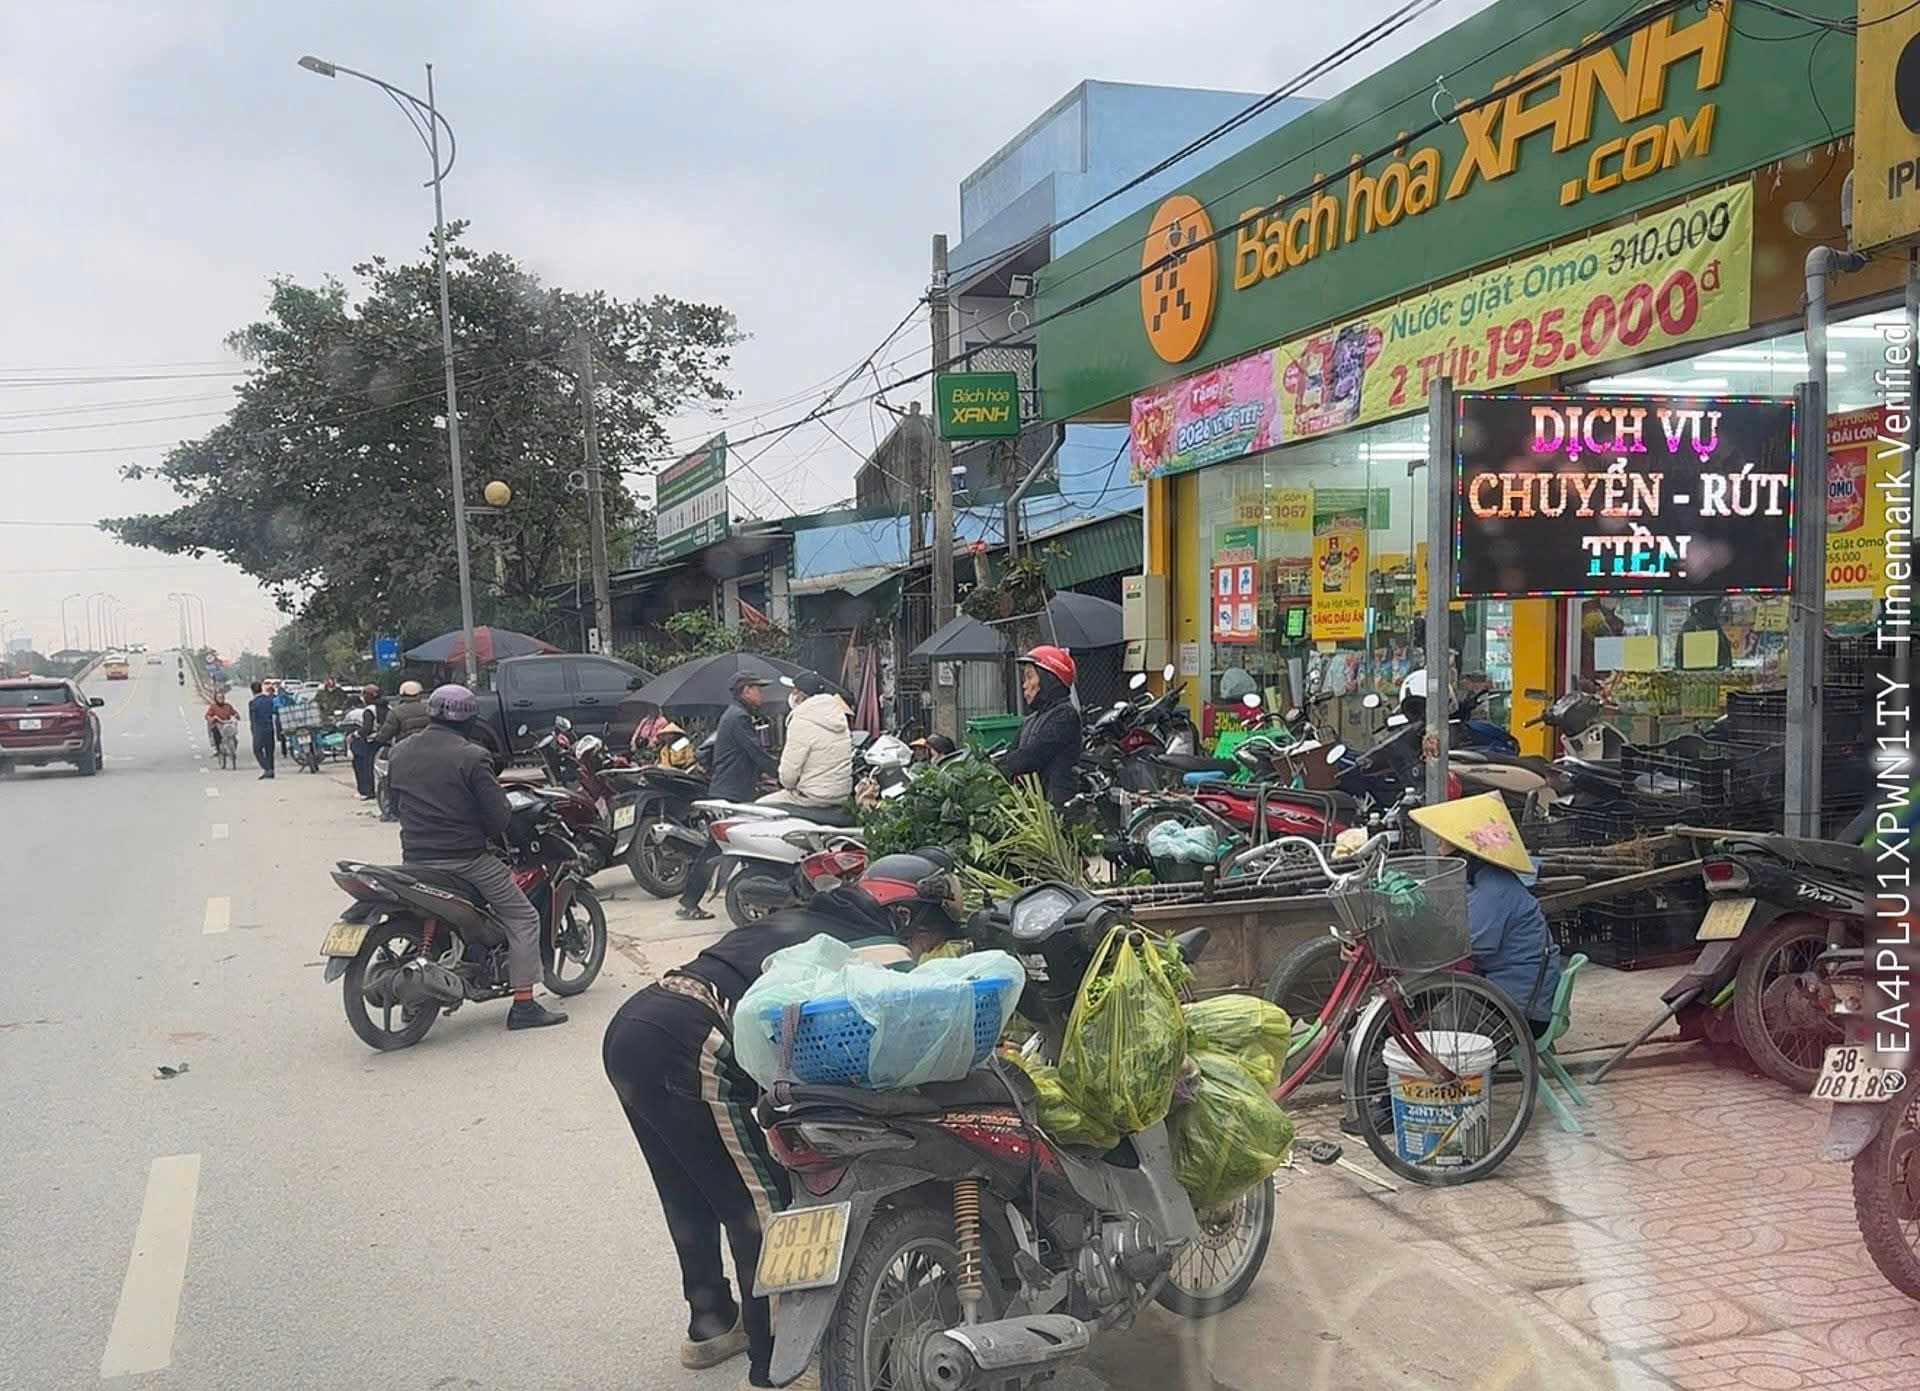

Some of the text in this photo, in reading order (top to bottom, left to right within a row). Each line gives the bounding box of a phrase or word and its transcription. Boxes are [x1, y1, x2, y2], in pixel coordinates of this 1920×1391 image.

[1233, 0, 1732, 290] Bách hóa XANH
[1560, 103, 1717, 206] .COM
[1389, 201, 1730, 342] Nước giặt Omo 310.000
[951, 386, 1010, 404] Bách hóa
[1388, 364, 1408, 406] 2
[951, 406, 1010, 424] XANH
[1531, 406, 1722, 463] DỊCH VỤ
[1239, 504, 1306, 519] 180 1067
[1468, 457, 1789, 519] CHUYỂN - RÚT
[1829, 481, 1852, 497] OMO
[1582, 522, 1691, 578] TIỀN
[1857, 537, 1884, 548] Omo
